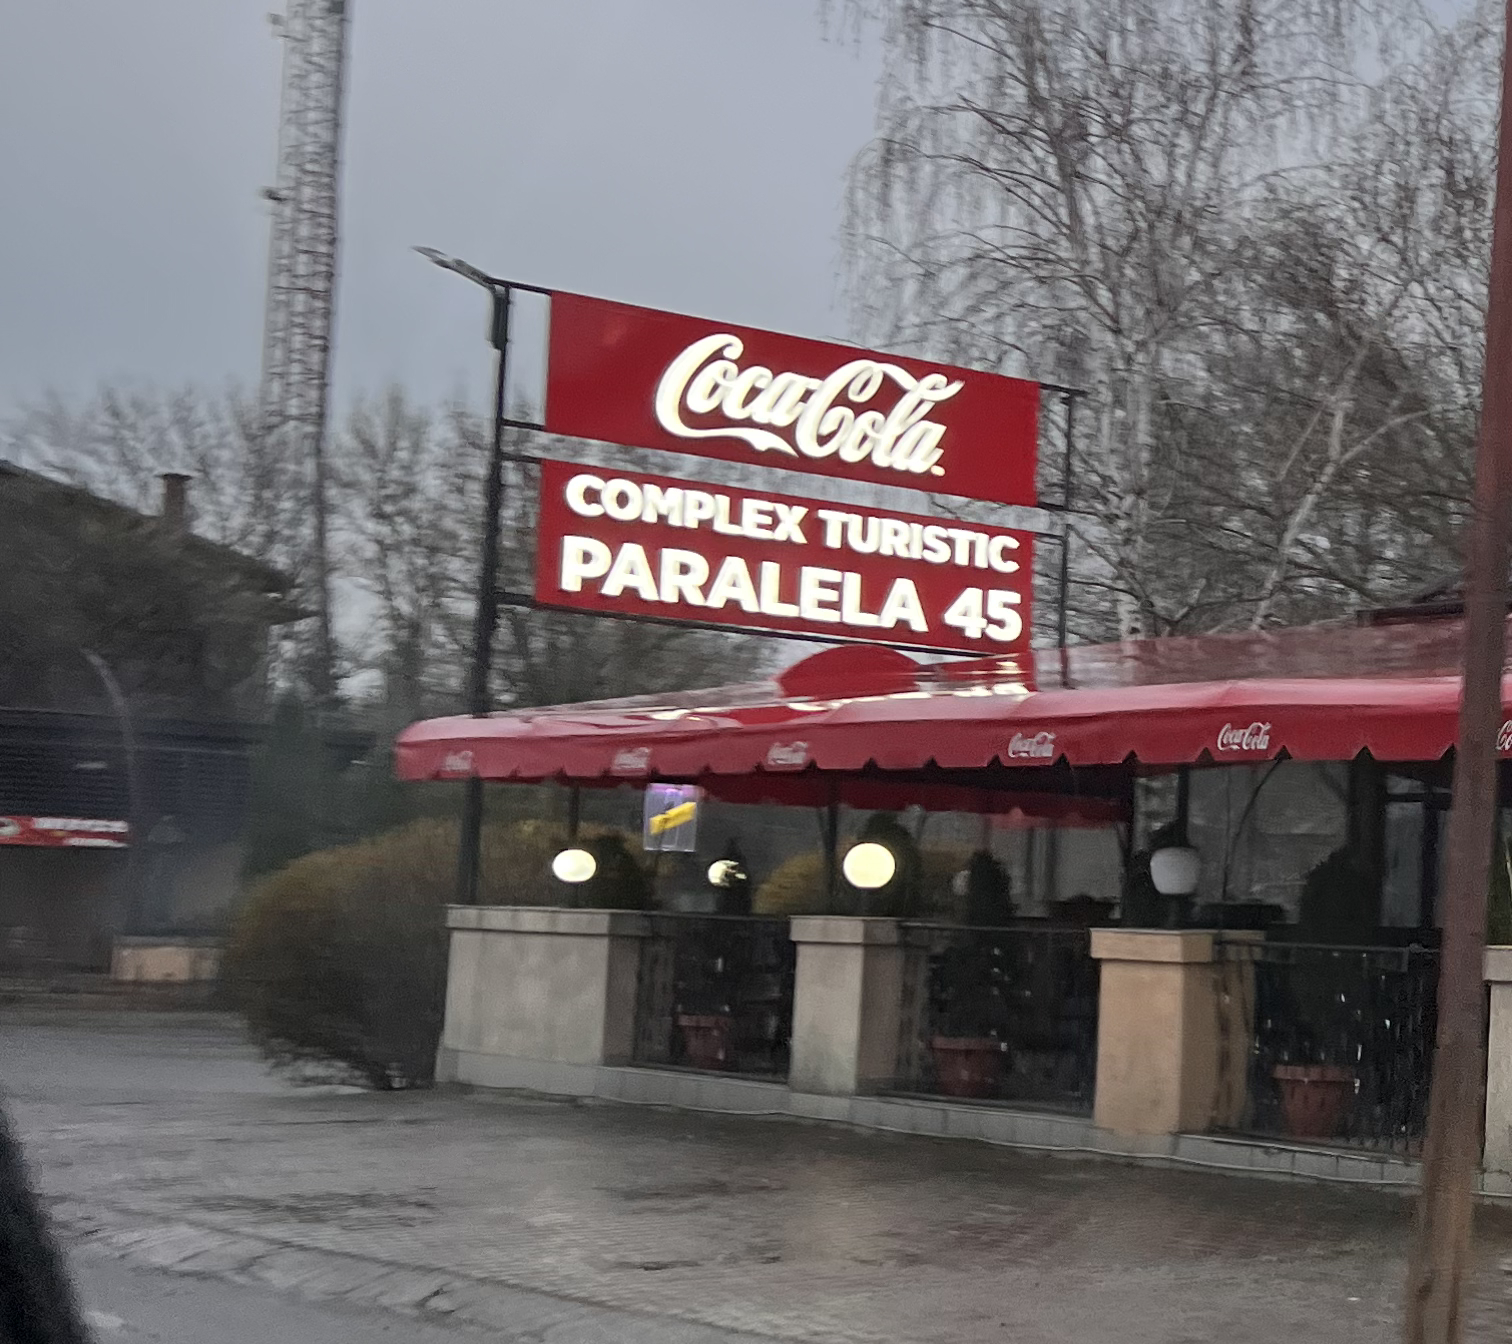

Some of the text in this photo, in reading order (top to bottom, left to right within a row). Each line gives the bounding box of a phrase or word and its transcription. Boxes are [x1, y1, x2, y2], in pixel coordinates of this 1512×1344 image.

[653, 333, 965, 476] Coca-Cola
[564, 474, 1021, 574] COMPLEX TURISTIC
[559, 534, 1023, 642] PARALELA 45
